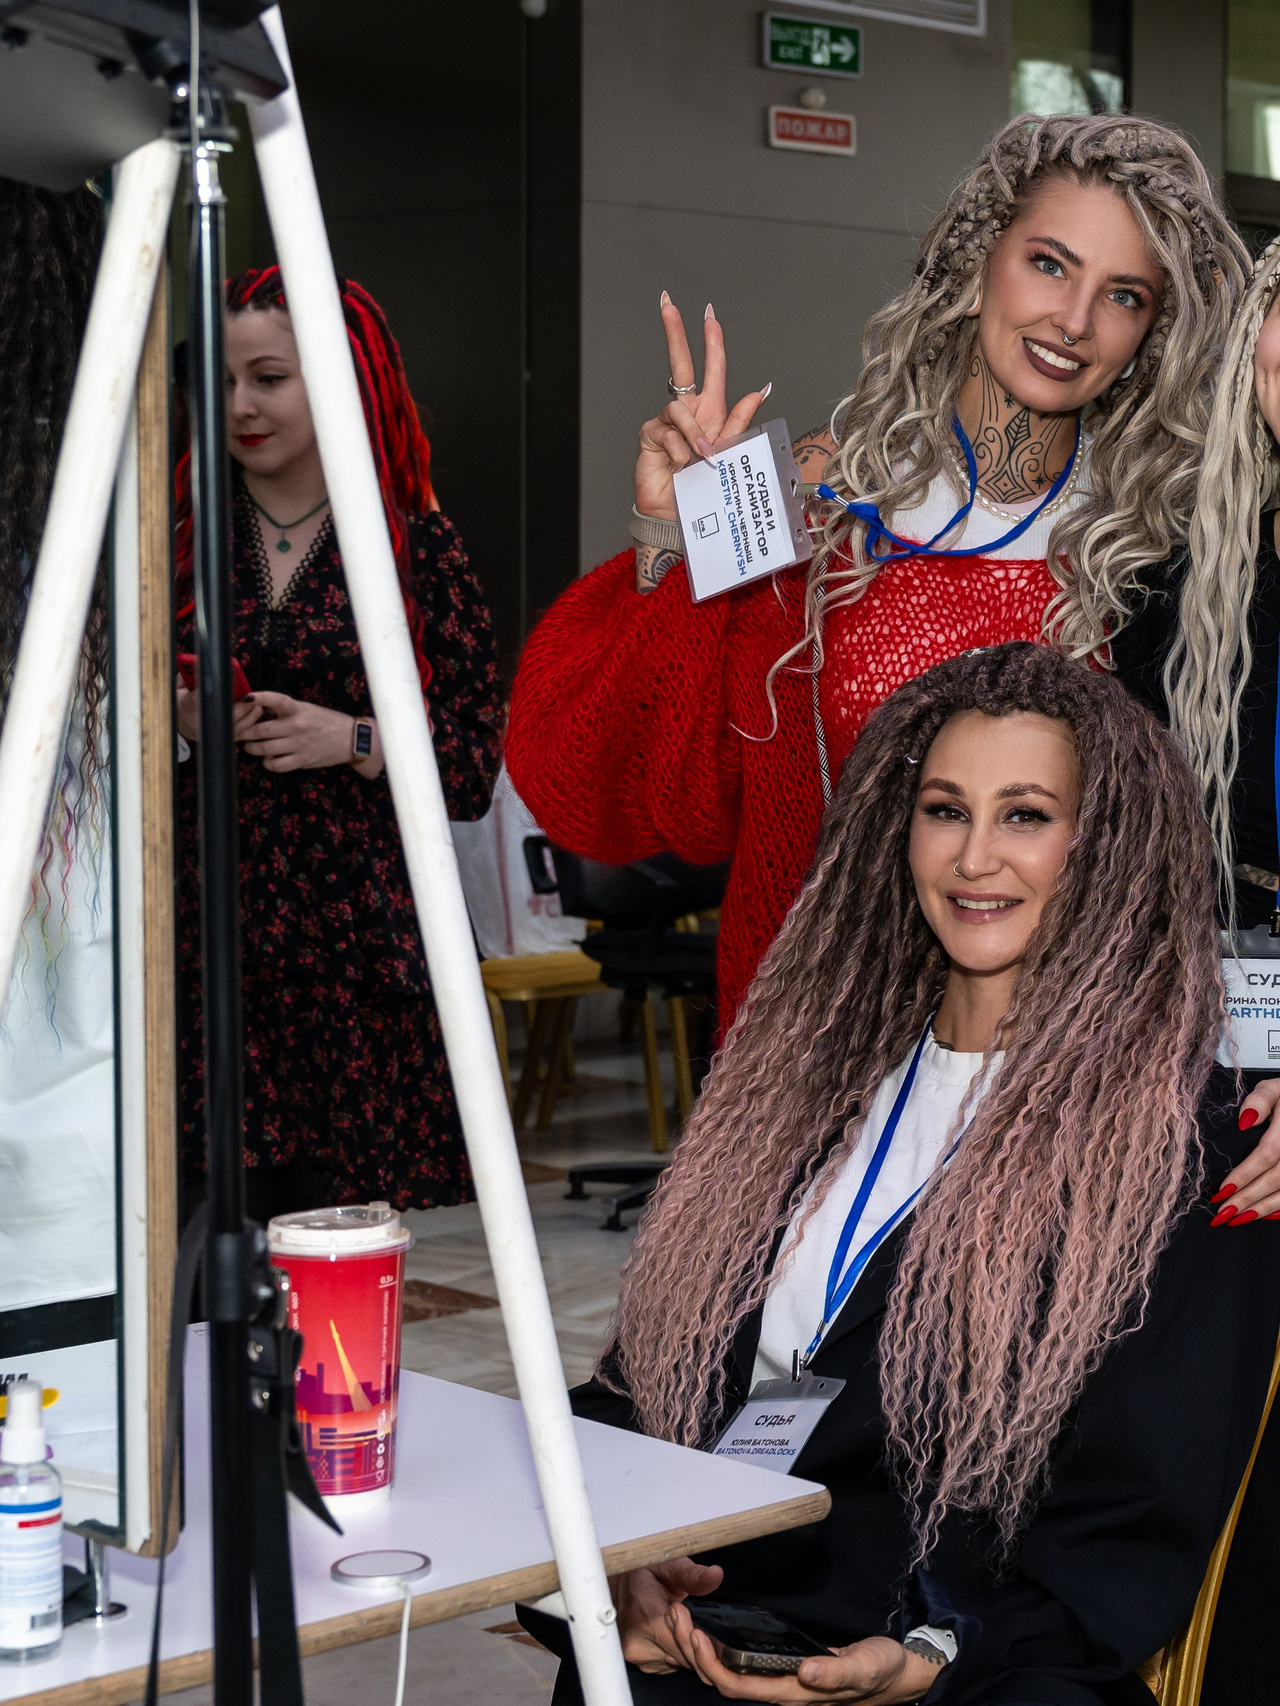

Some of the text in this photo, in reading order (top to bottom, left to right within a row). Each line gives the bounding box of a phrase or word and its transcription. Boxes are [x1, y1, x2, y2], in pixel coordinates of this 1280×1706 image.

[777, 117, 848, 142] ПОЖАР
[727, 462, 753, 563] КРИСТИНА ЧЕРНЫШ
[740, 454, 768, 557] ОРГАНИЗАТОР
[756, 471, 776, 531] СУДЬЯ И
[1223, 996, 1257, 1005] РИНА
[754, 1414, 796, 1428] СУДЬЯ
[752, 1438, 790, 1446] БАТОНОВА
